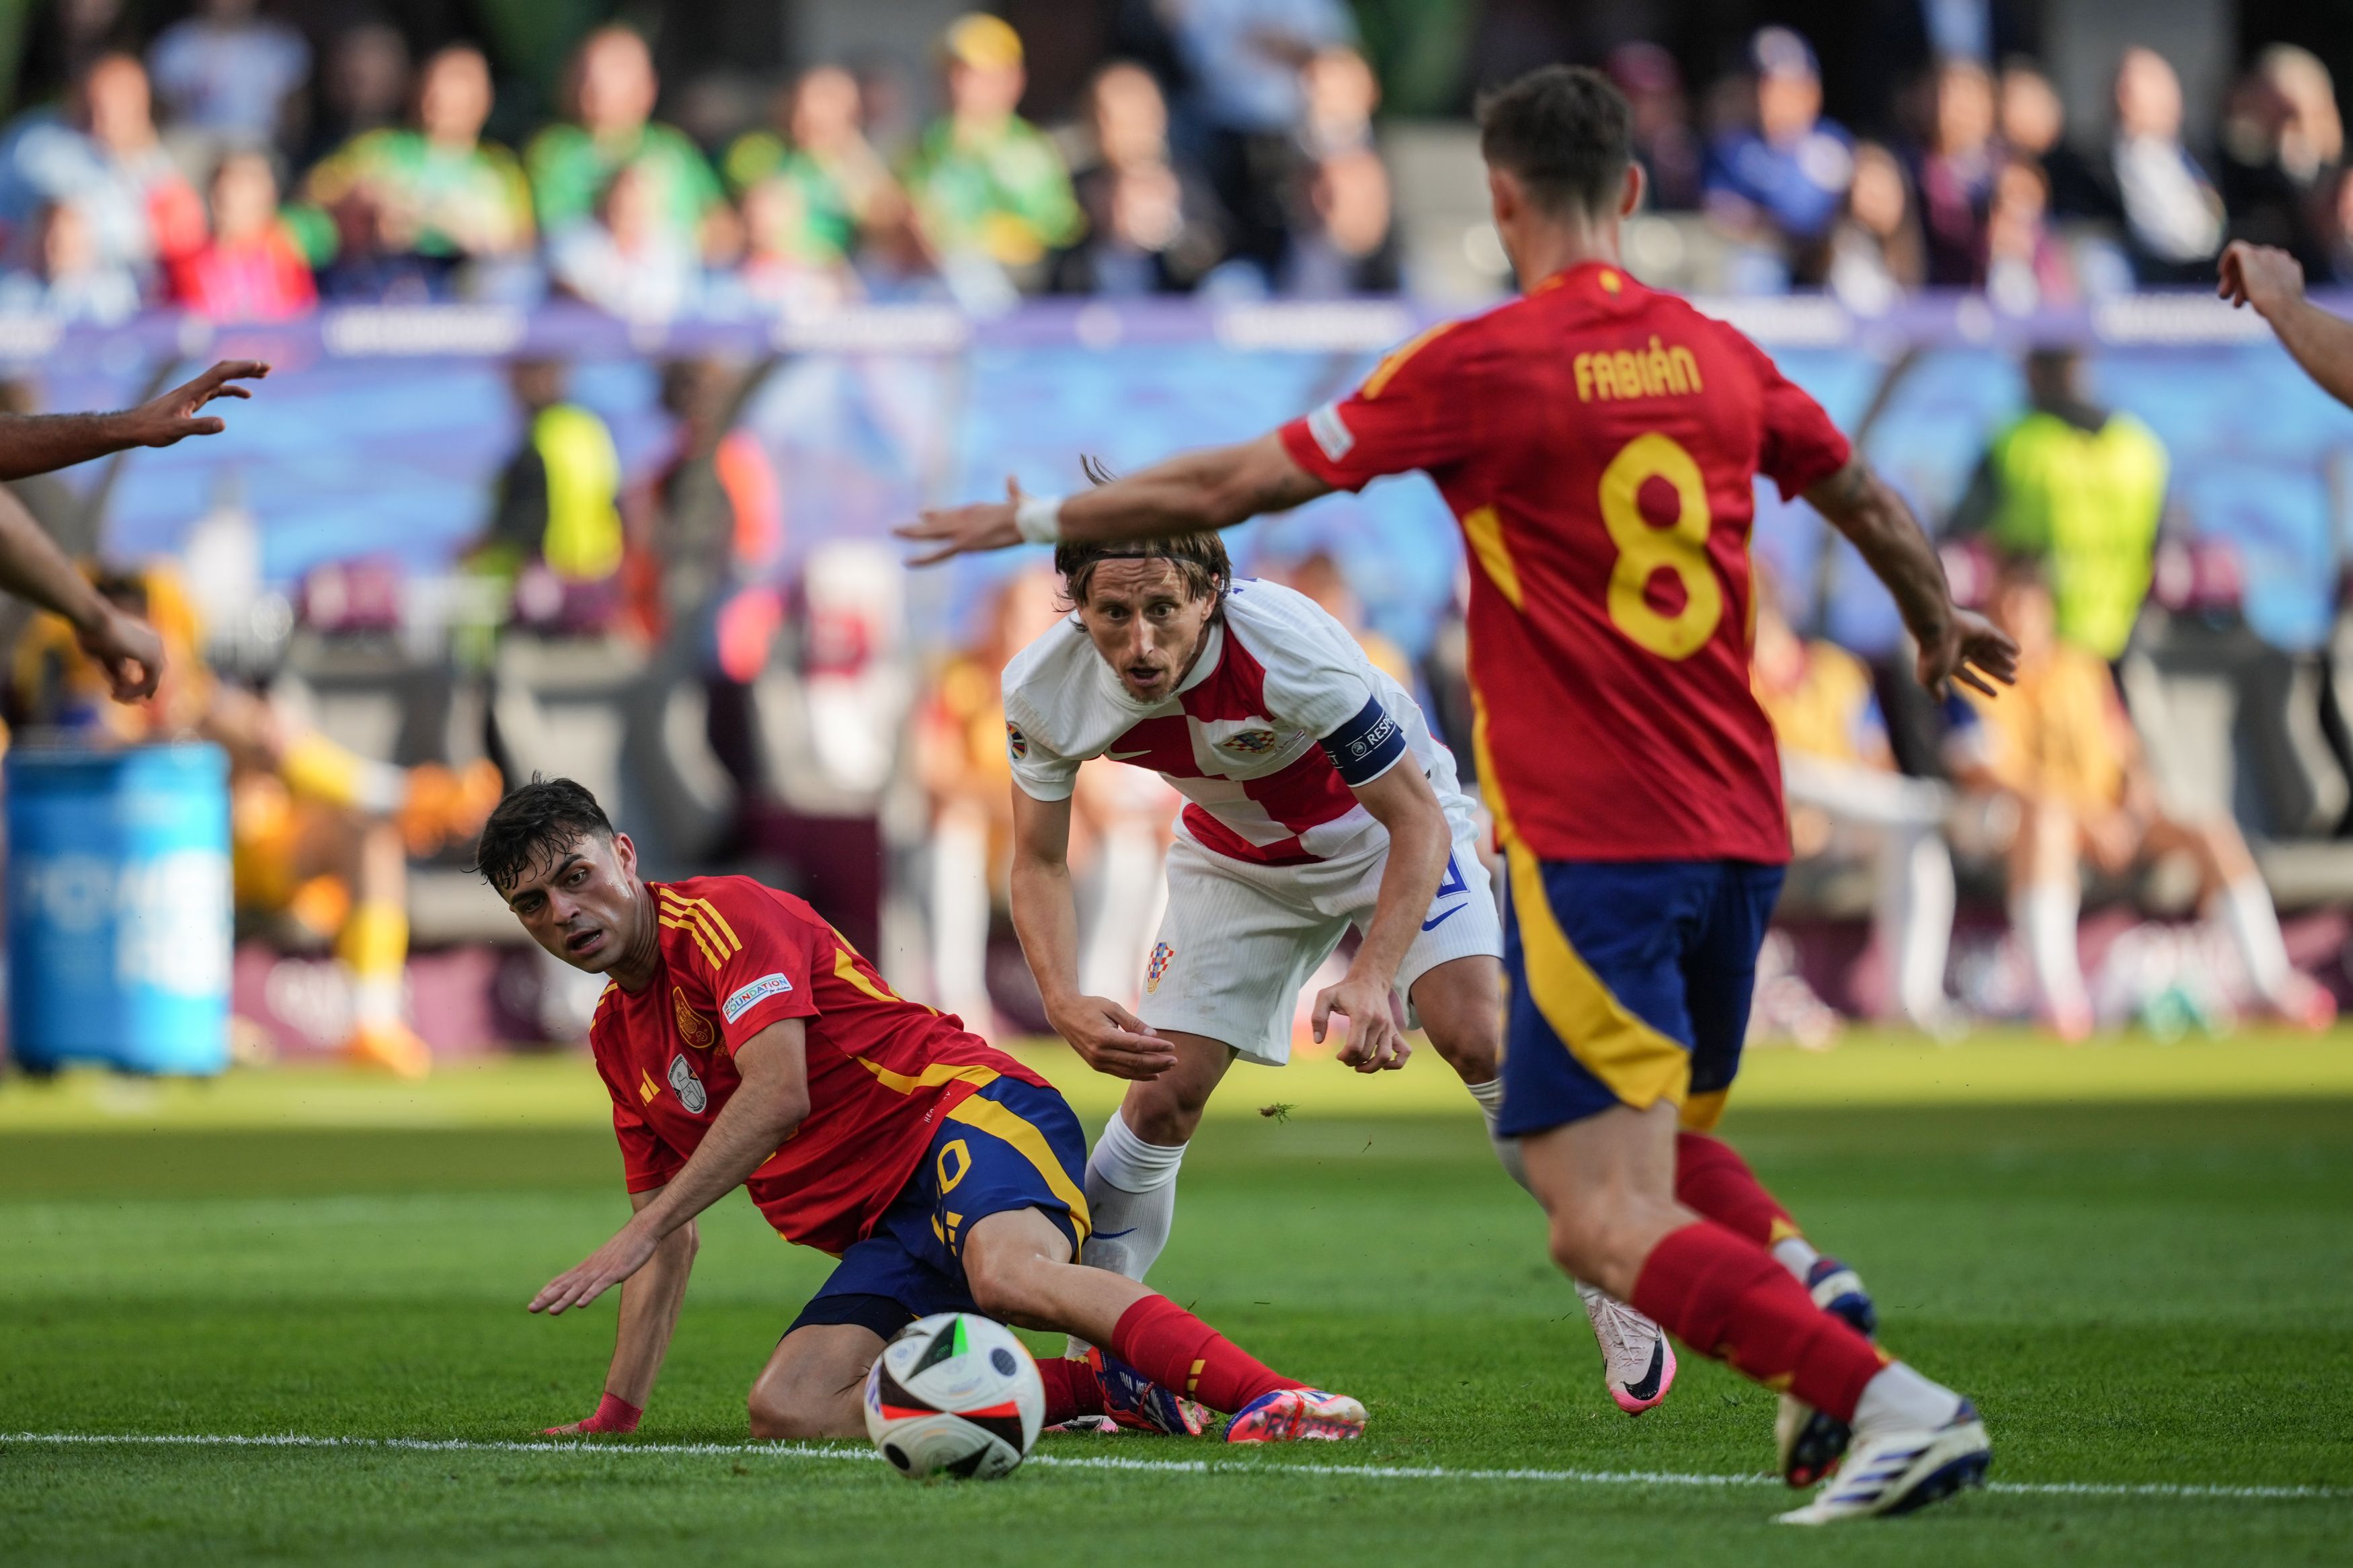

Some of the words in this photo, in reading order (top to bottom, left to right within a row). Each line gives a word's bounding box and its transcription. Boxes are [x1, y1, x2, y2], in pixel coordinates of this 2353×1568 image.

[1572, 334, 1704, 403] FABIÁN
[1597, 431, 1722, 661] 8
[726, 979, 787, 1017] FOUNDATION
